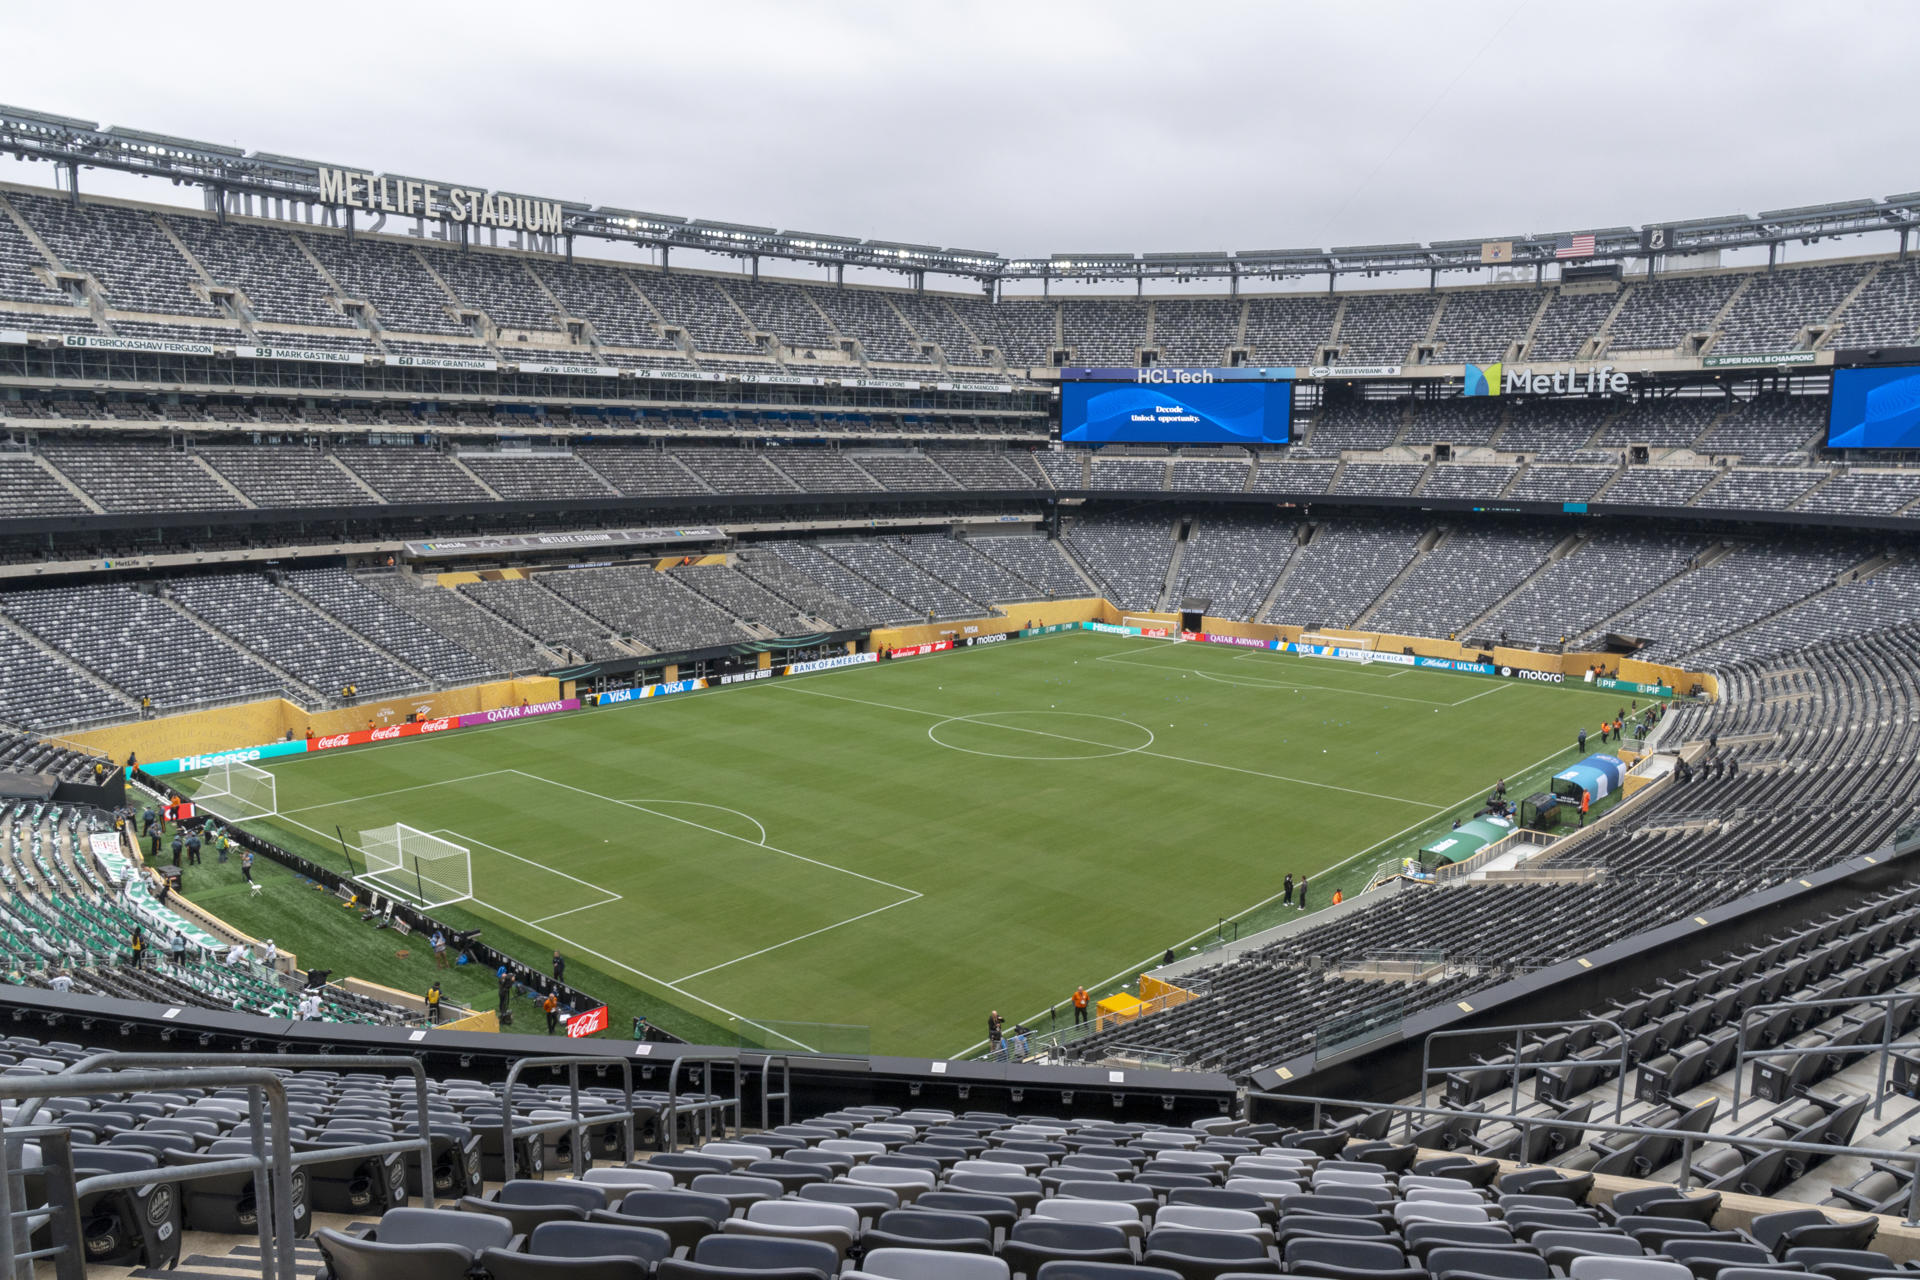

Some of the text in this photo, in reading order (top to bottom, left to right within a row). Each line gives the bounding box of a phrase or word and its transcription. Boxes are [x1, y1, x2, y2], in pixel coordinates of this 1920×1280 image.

[319, 167, 440, 218] METLIFE
[450, 188, 563, 234] STADIUM
[66, 335, 212, 353] 60 D'BRICKASHAW FERGUSON
[255, 347, 350, 362] 99 MARK GASTINEAU
[1742, 356, 1764, 364] BOWL
[1771, 354, 1814, 362] CHAMPIONS
[398, 356, 486, 368] 60 LARRY GRANTHAM
[640, 369, 650, 377] 75
[660, 371, 688, 379] WINSTON
[1137, 369, 1214, 384] HCLTech
[1506, 366, 1629, 394] MetLife
[1156, 406, 1184, 414] Decode
[539, 534, 612, 544] METLIFE STADIUM
[435, 542, 467, 550] MetLife
[114, 560, 140, 568] MetLife
[1092, 622, 1130, 635] Hisense
[976, 632, 1006, 645] motorola
[1210, 634, 1264, 648] QATAR AIRWAYS
[1295, 644, 1314, 654] VISA
[1340, 650, 1358, 658] BANK
[1371, 654, 1403, 662] AMERICA
[794, 654, 866, 673] BANK OF AMERICA
[1456, 663, 1486, 672] ULTRA
[721, 670, 772, 684] NEW YORK NEW JERSEY
[664, 682, 684, 694] VISA
[1602, 680, 1616, 688] PIF
[1646, 686, 1660, 694] PIF
[609, 690, 632, 702] VISA
[488, 700, 562, 722] QATAR AIRWAYS
[420, 718, 450, 734] Coca-Cola
[371, 725, 401, 742] Coca-Cola
[318, 734, 350, 750] Coca-Cola
[179, 748, 261, 772] Hisense
[161, 1226, 170, 1237] 10
